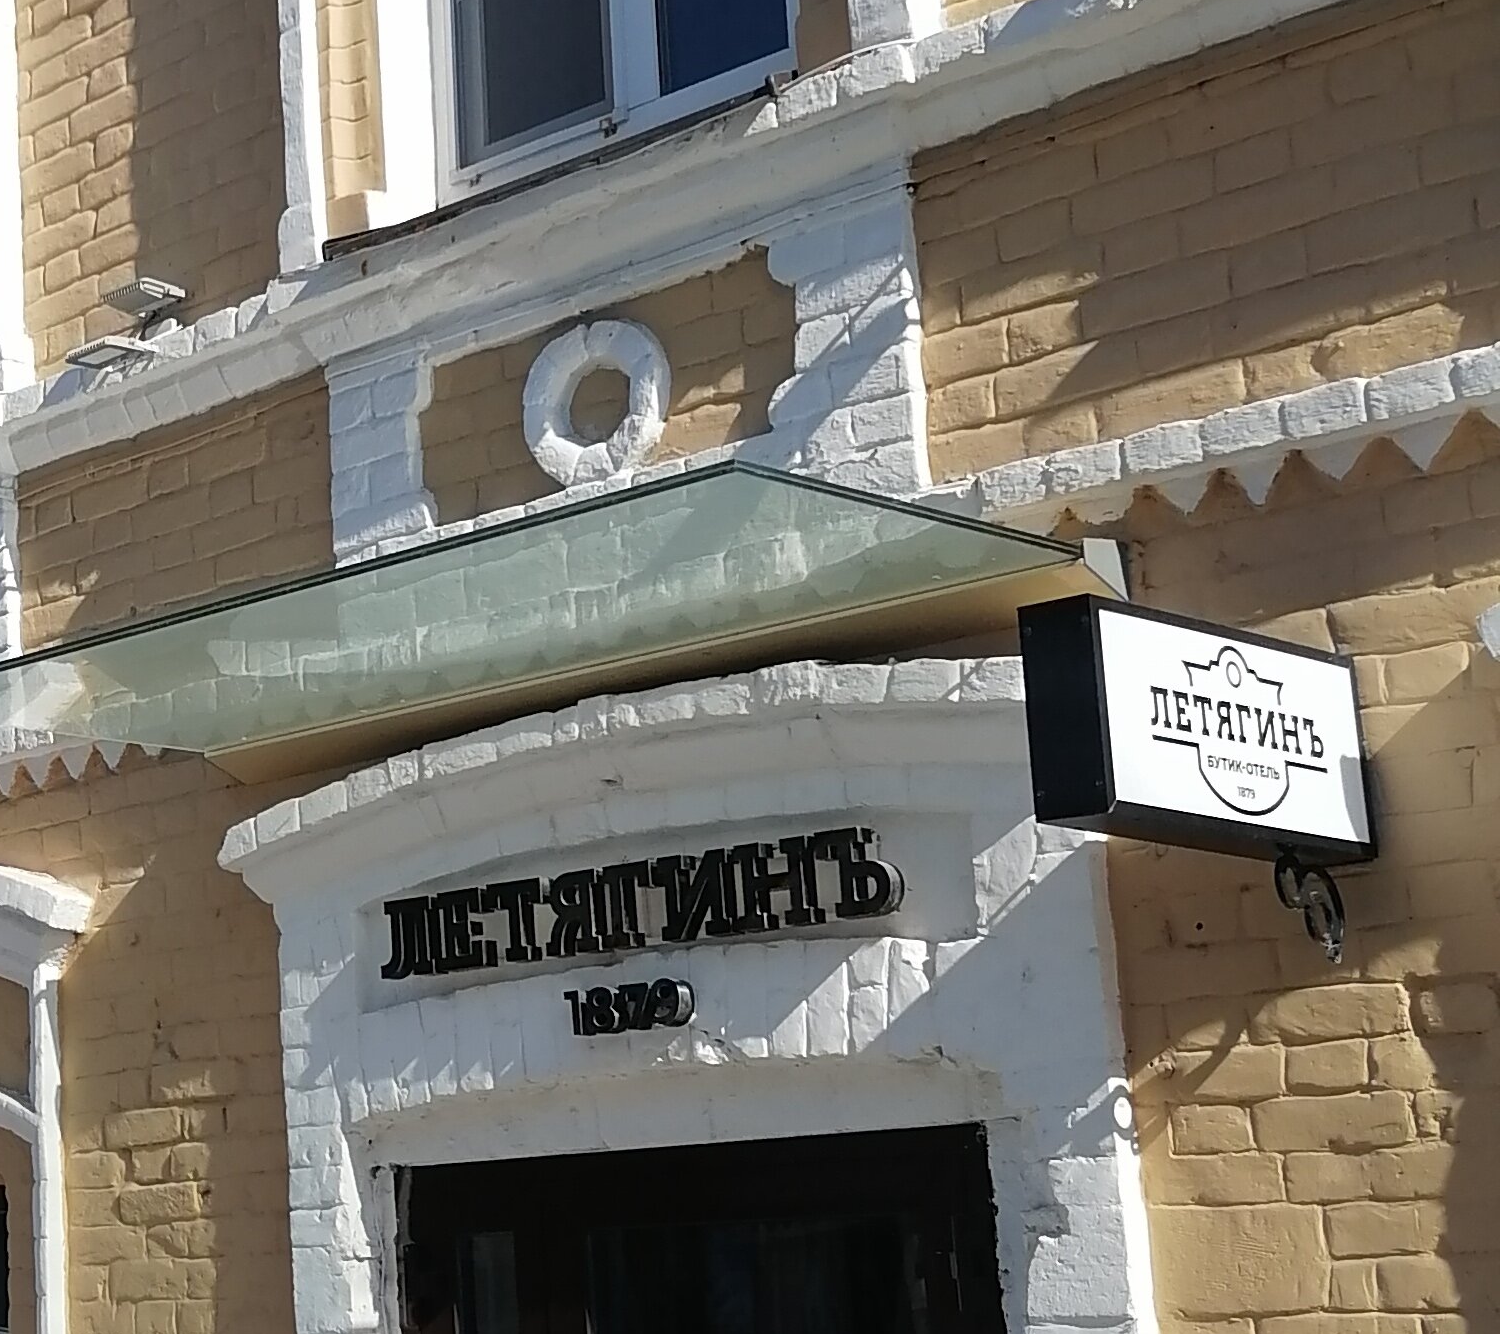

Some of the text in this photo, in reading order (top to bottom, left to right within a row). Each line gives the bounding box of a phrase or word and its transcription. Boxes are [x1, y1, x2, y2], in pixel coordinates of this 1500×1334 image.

[1150, 686, 1324, 758] ЛЕТЯГИНЪ
[1207, 755, 1280, 780] БУТИК-ОТЕЛЬ
[381, 827, 905, 979] ЛЕТЯГИНЪ
[564, 978, 695, 1035] 1879
